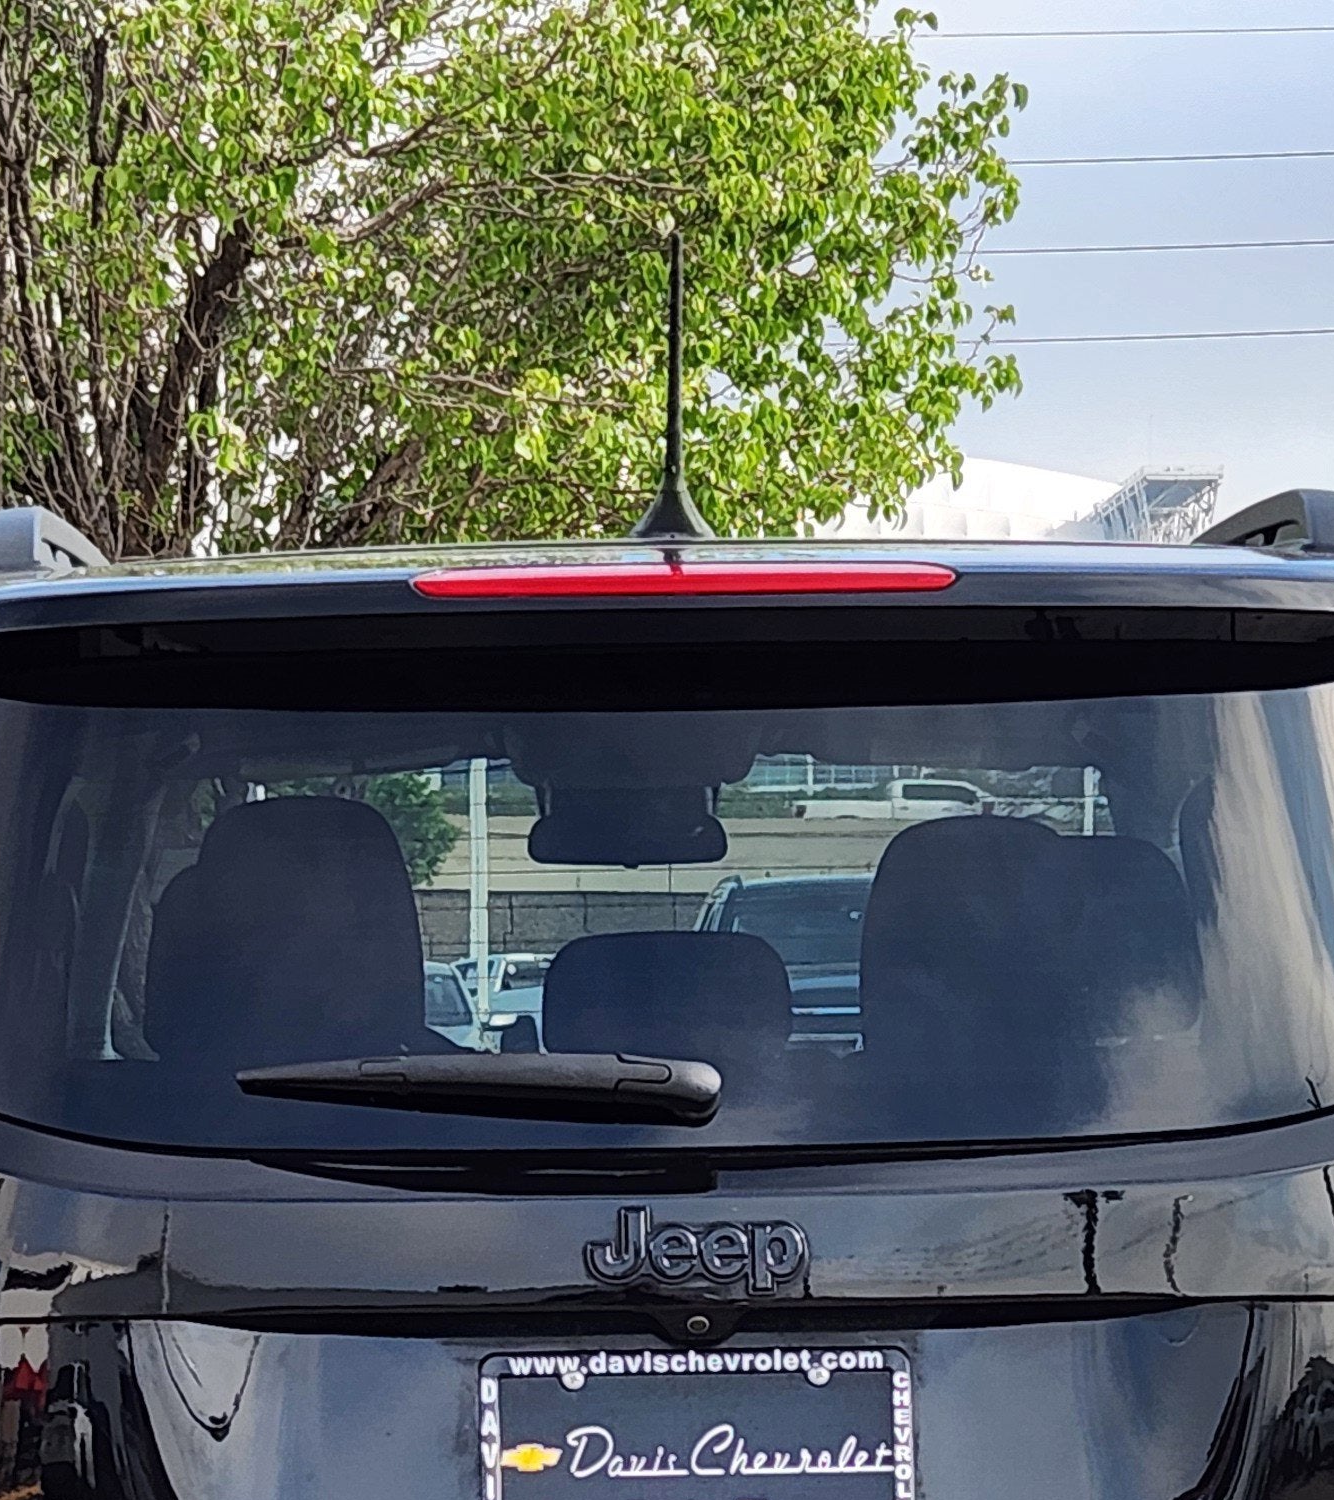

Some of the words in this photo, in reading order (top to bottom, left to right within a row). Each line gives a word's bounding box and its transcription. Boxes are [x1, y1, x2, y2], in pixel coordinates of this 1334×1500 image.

[584, 1205, 810, 1297] Jeep
[508, 1349, 884, 1375] www.davischevrolet.com
[566, 1425, 689, 1478] Davis
[690, 1423, 894, 1476] Chevrolet
